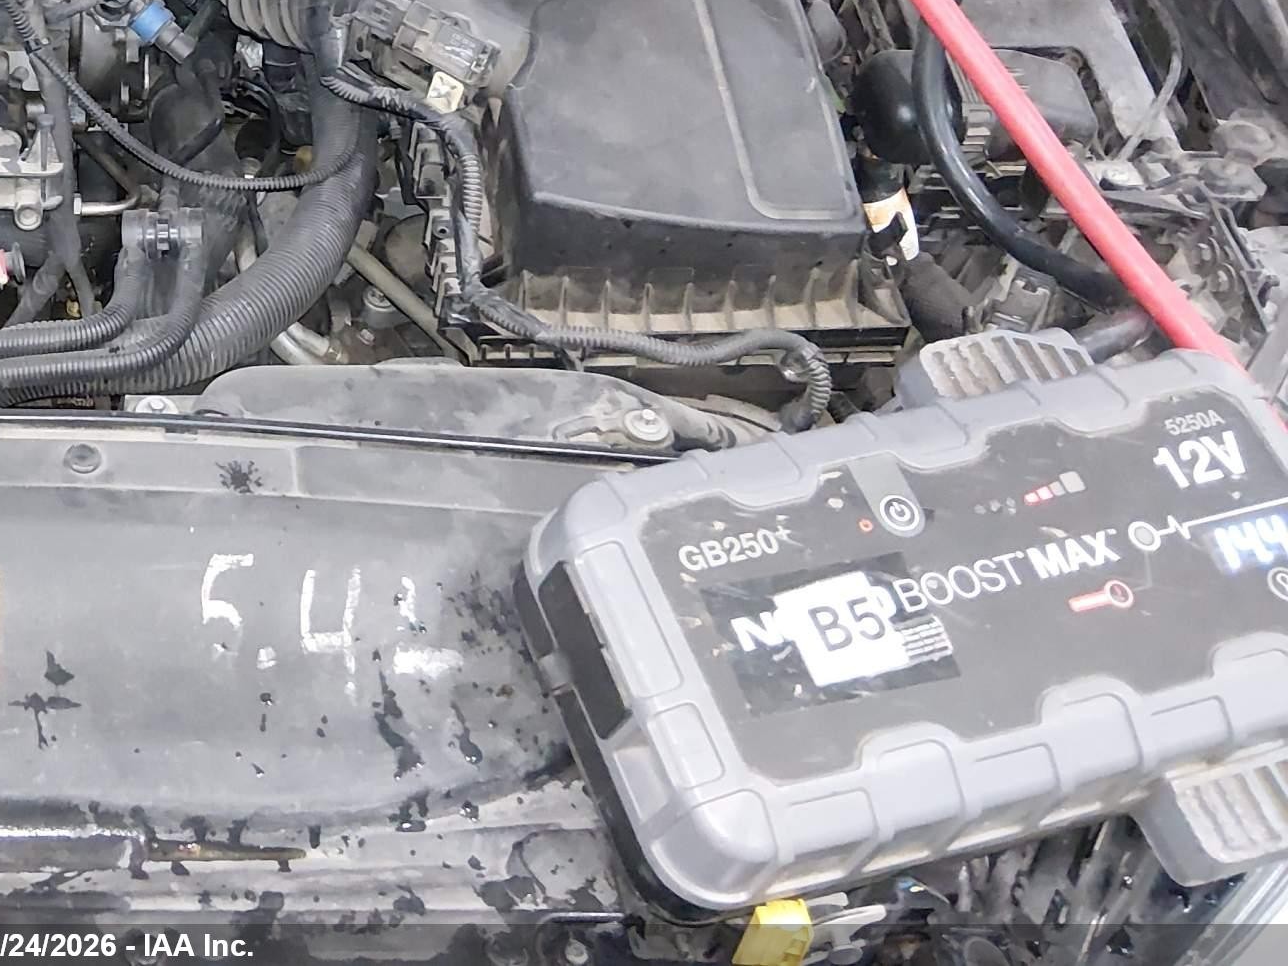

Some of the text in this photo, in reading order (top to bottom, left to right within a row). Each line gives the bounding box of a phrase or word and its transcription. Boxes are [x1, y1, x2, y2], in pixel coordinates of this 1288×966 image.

[1165, 409, 1226, 436] 5250A
[1153, 431, 1246, 489] 12V
[808, 595, 887, 653] B5
